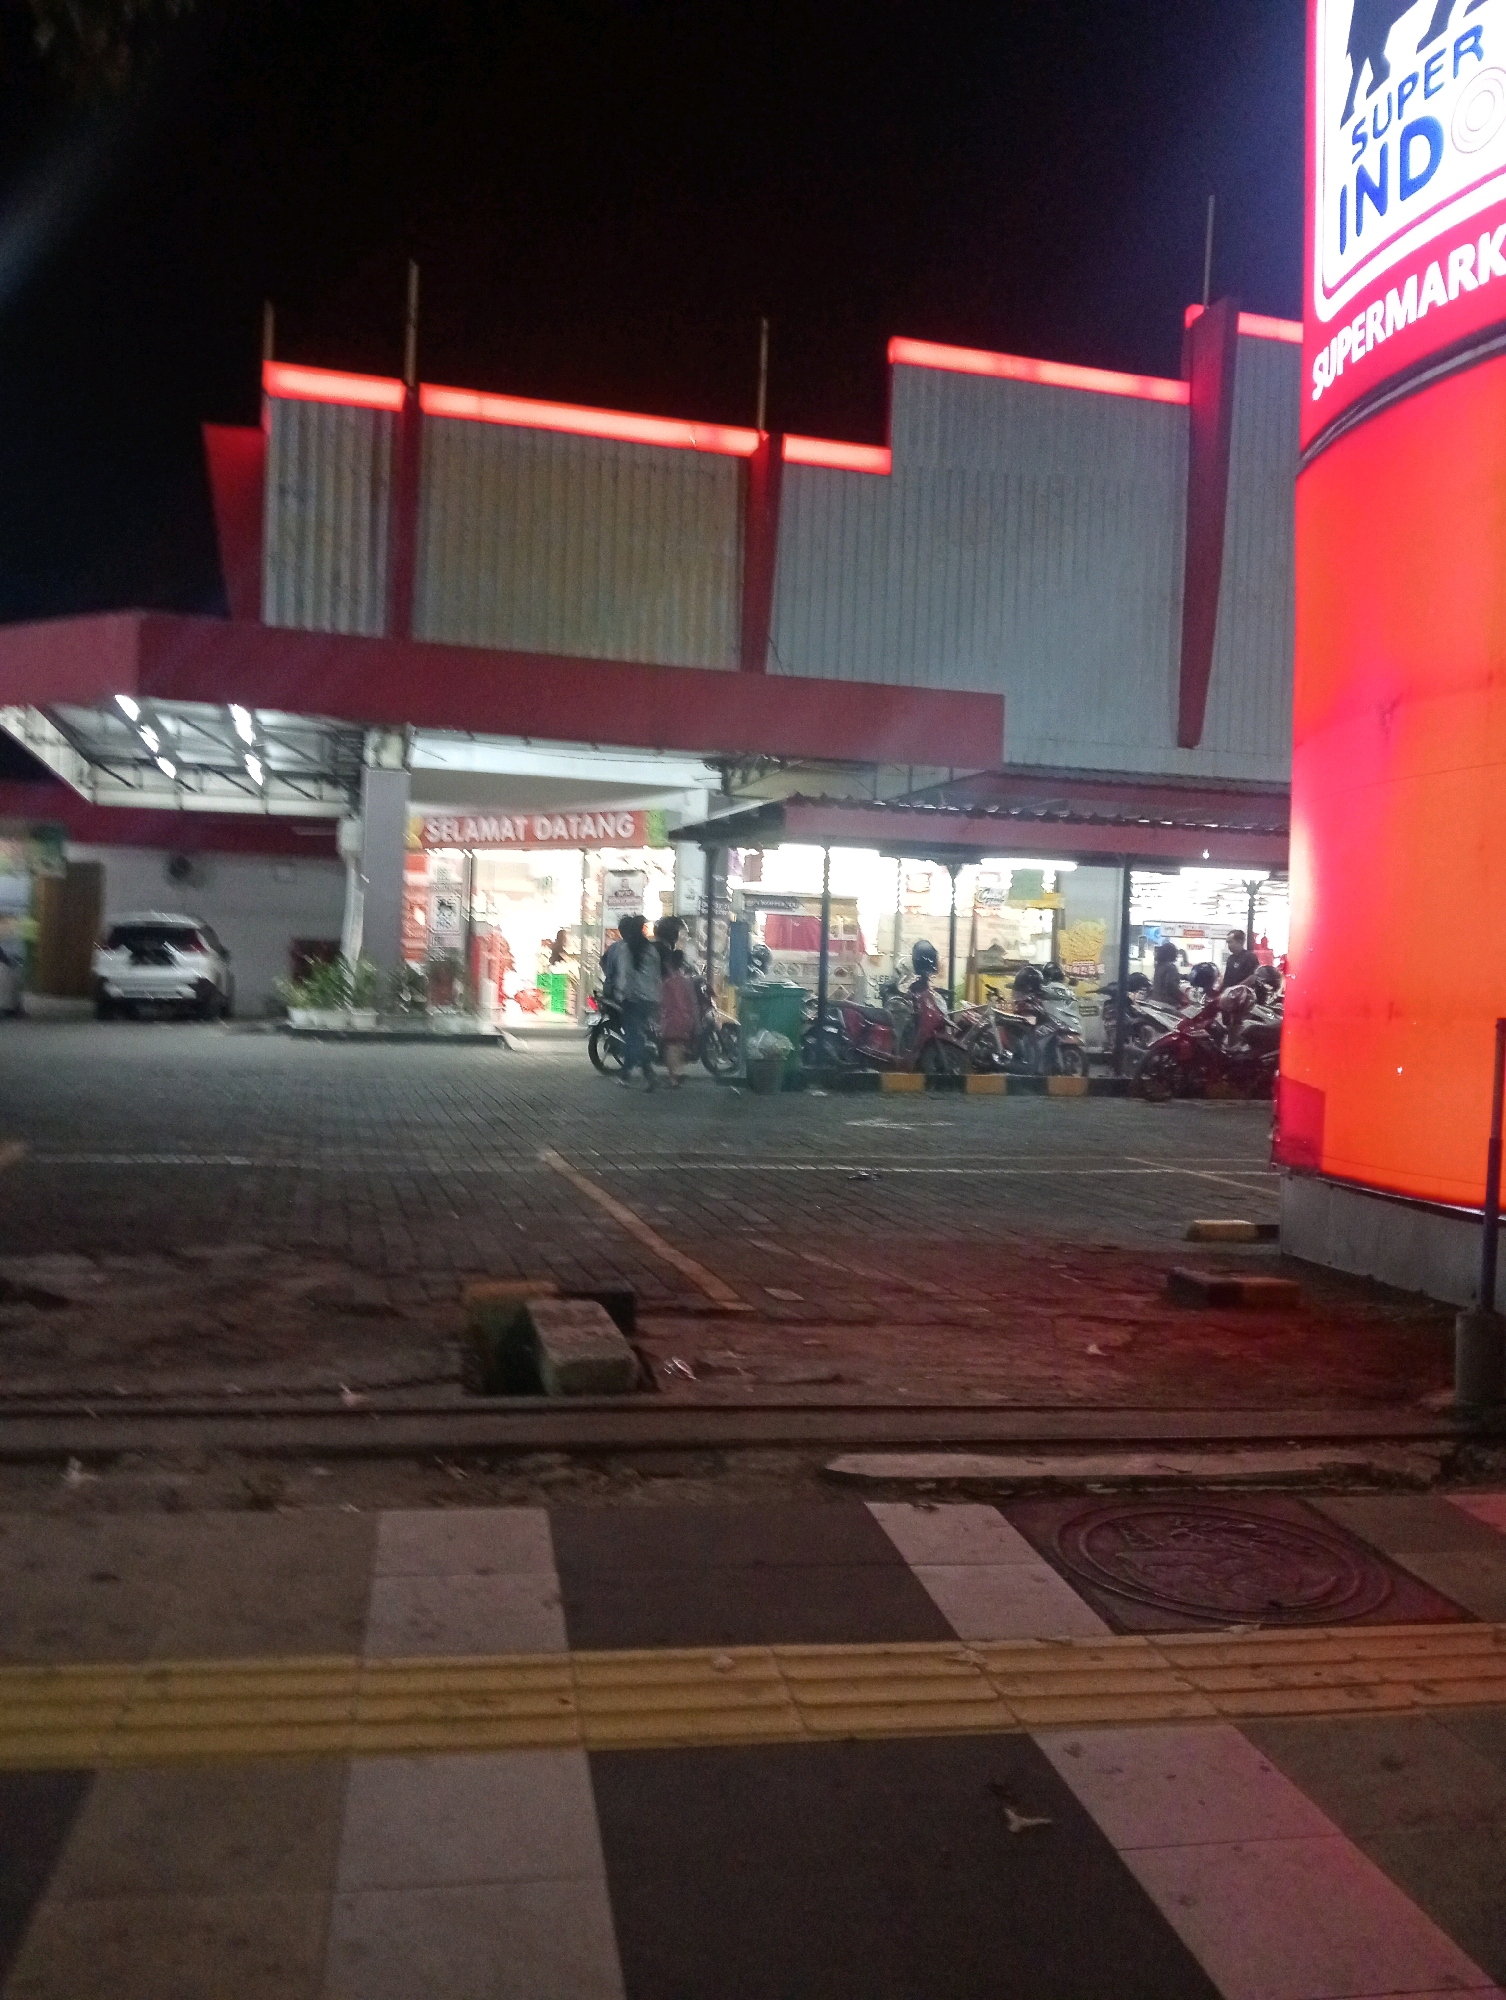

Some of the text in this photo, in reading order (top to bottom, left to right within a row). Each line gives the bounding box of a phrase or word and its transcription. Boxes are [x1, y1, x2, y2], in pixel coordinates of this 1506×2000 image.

[1352, 24, 1484, 165] SUPER
[1312, 223, 1506, 401] SUPERMARK
[424, 811, 635, 844] SELAMAT DATANG
